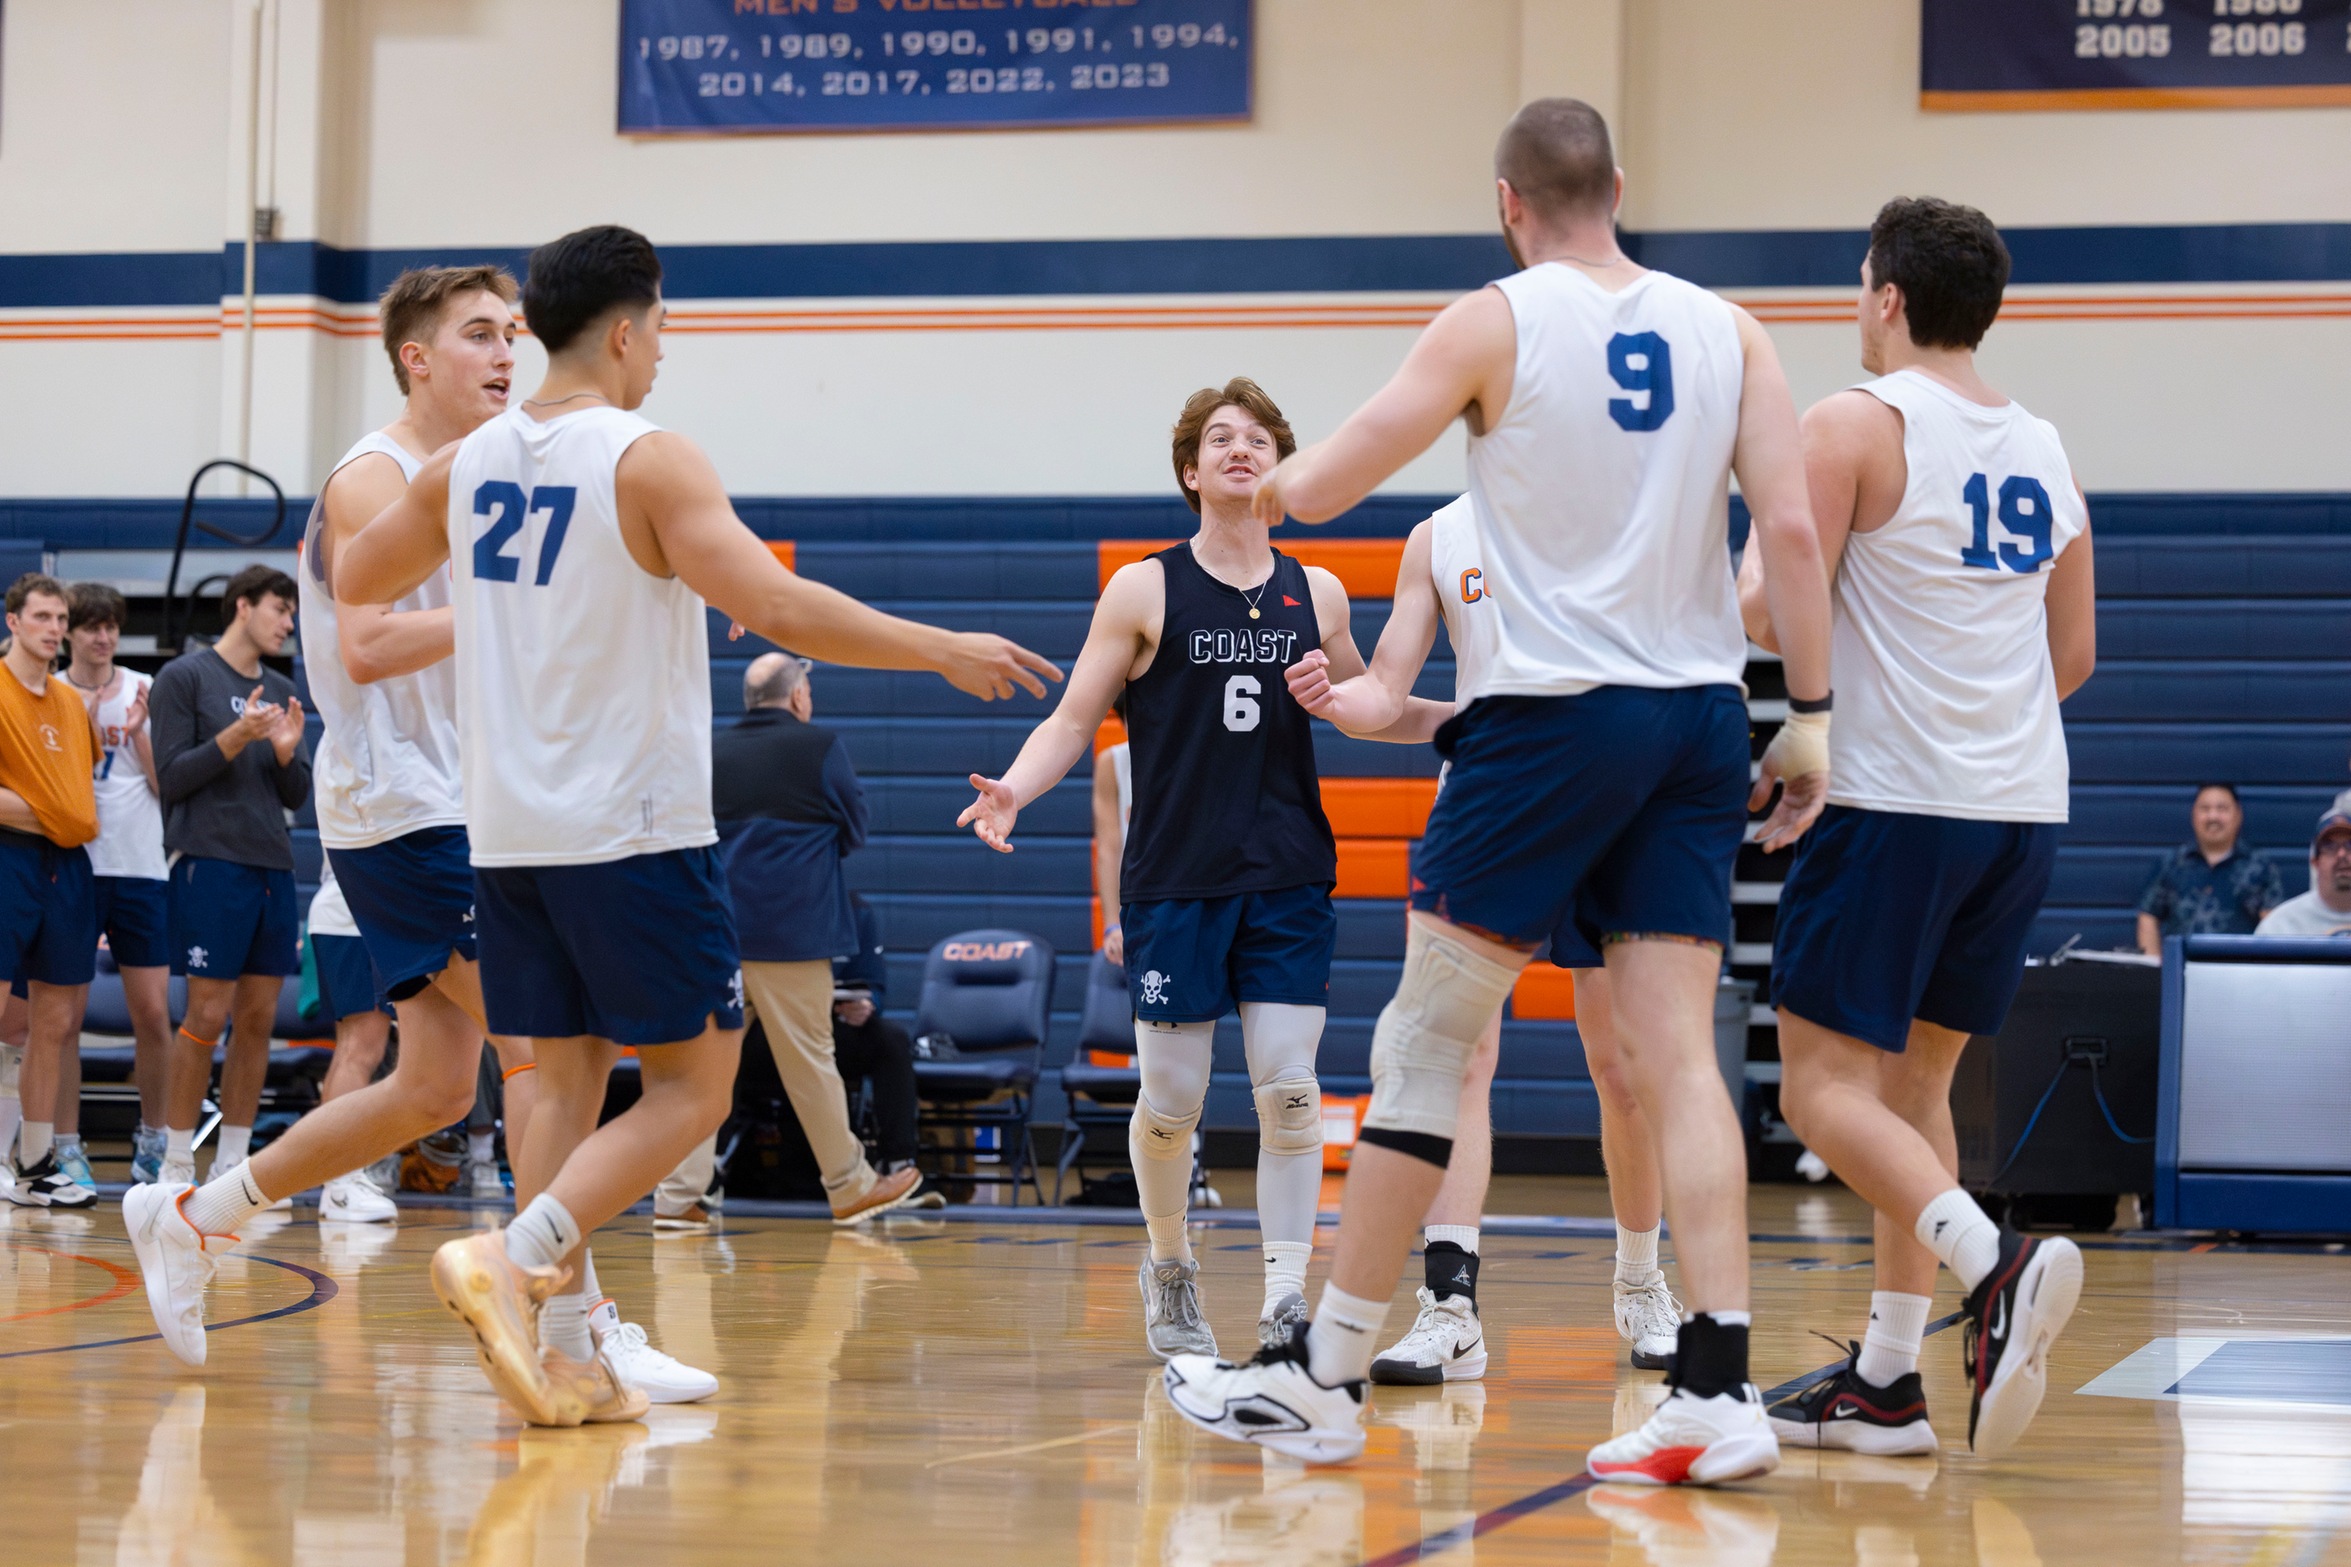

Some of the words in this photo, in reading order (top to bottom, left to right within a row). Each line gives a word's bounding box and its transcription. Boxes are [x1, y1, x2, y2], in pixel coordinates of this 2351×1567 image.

[734, 0, 858, 16] MENS
[2075, 23, 2171, 58] 2005
[2208, 21, 2306, 57] 2006
[1070, 62, 1170, 90] 2023
[1606, 330, 1675, 432] 9
[473, 480, 577, 586] 27
[1961, 472, 2054, 573] 19
[1189, 628, 1297, 664] COAST
[1223, 675, 1261, 732] 6
[943, 940, 1034, 961] COAST
